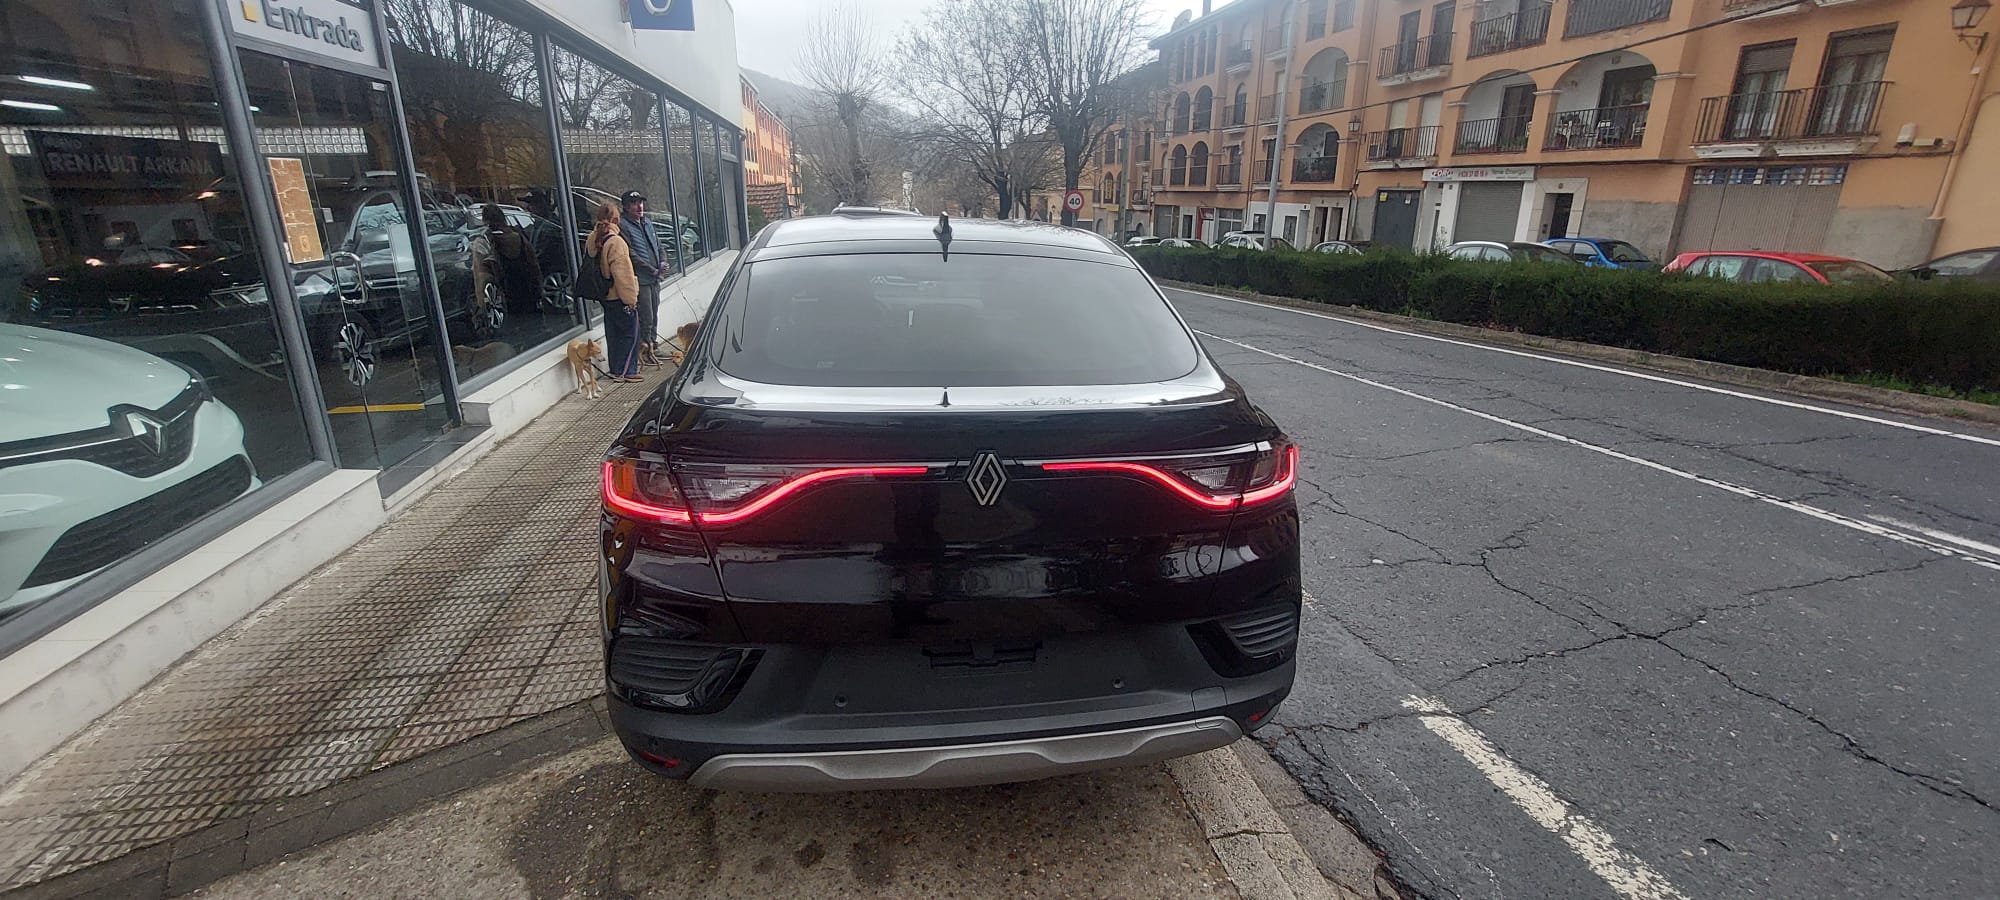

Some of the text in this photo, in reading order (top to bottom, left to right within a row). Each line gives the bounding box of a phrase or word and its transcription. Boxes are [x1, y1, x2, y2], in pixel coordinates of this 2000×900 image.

[263, 0, 364, 52] Entrada
[47, 152, 214, 176] RENAULT ARKANA
